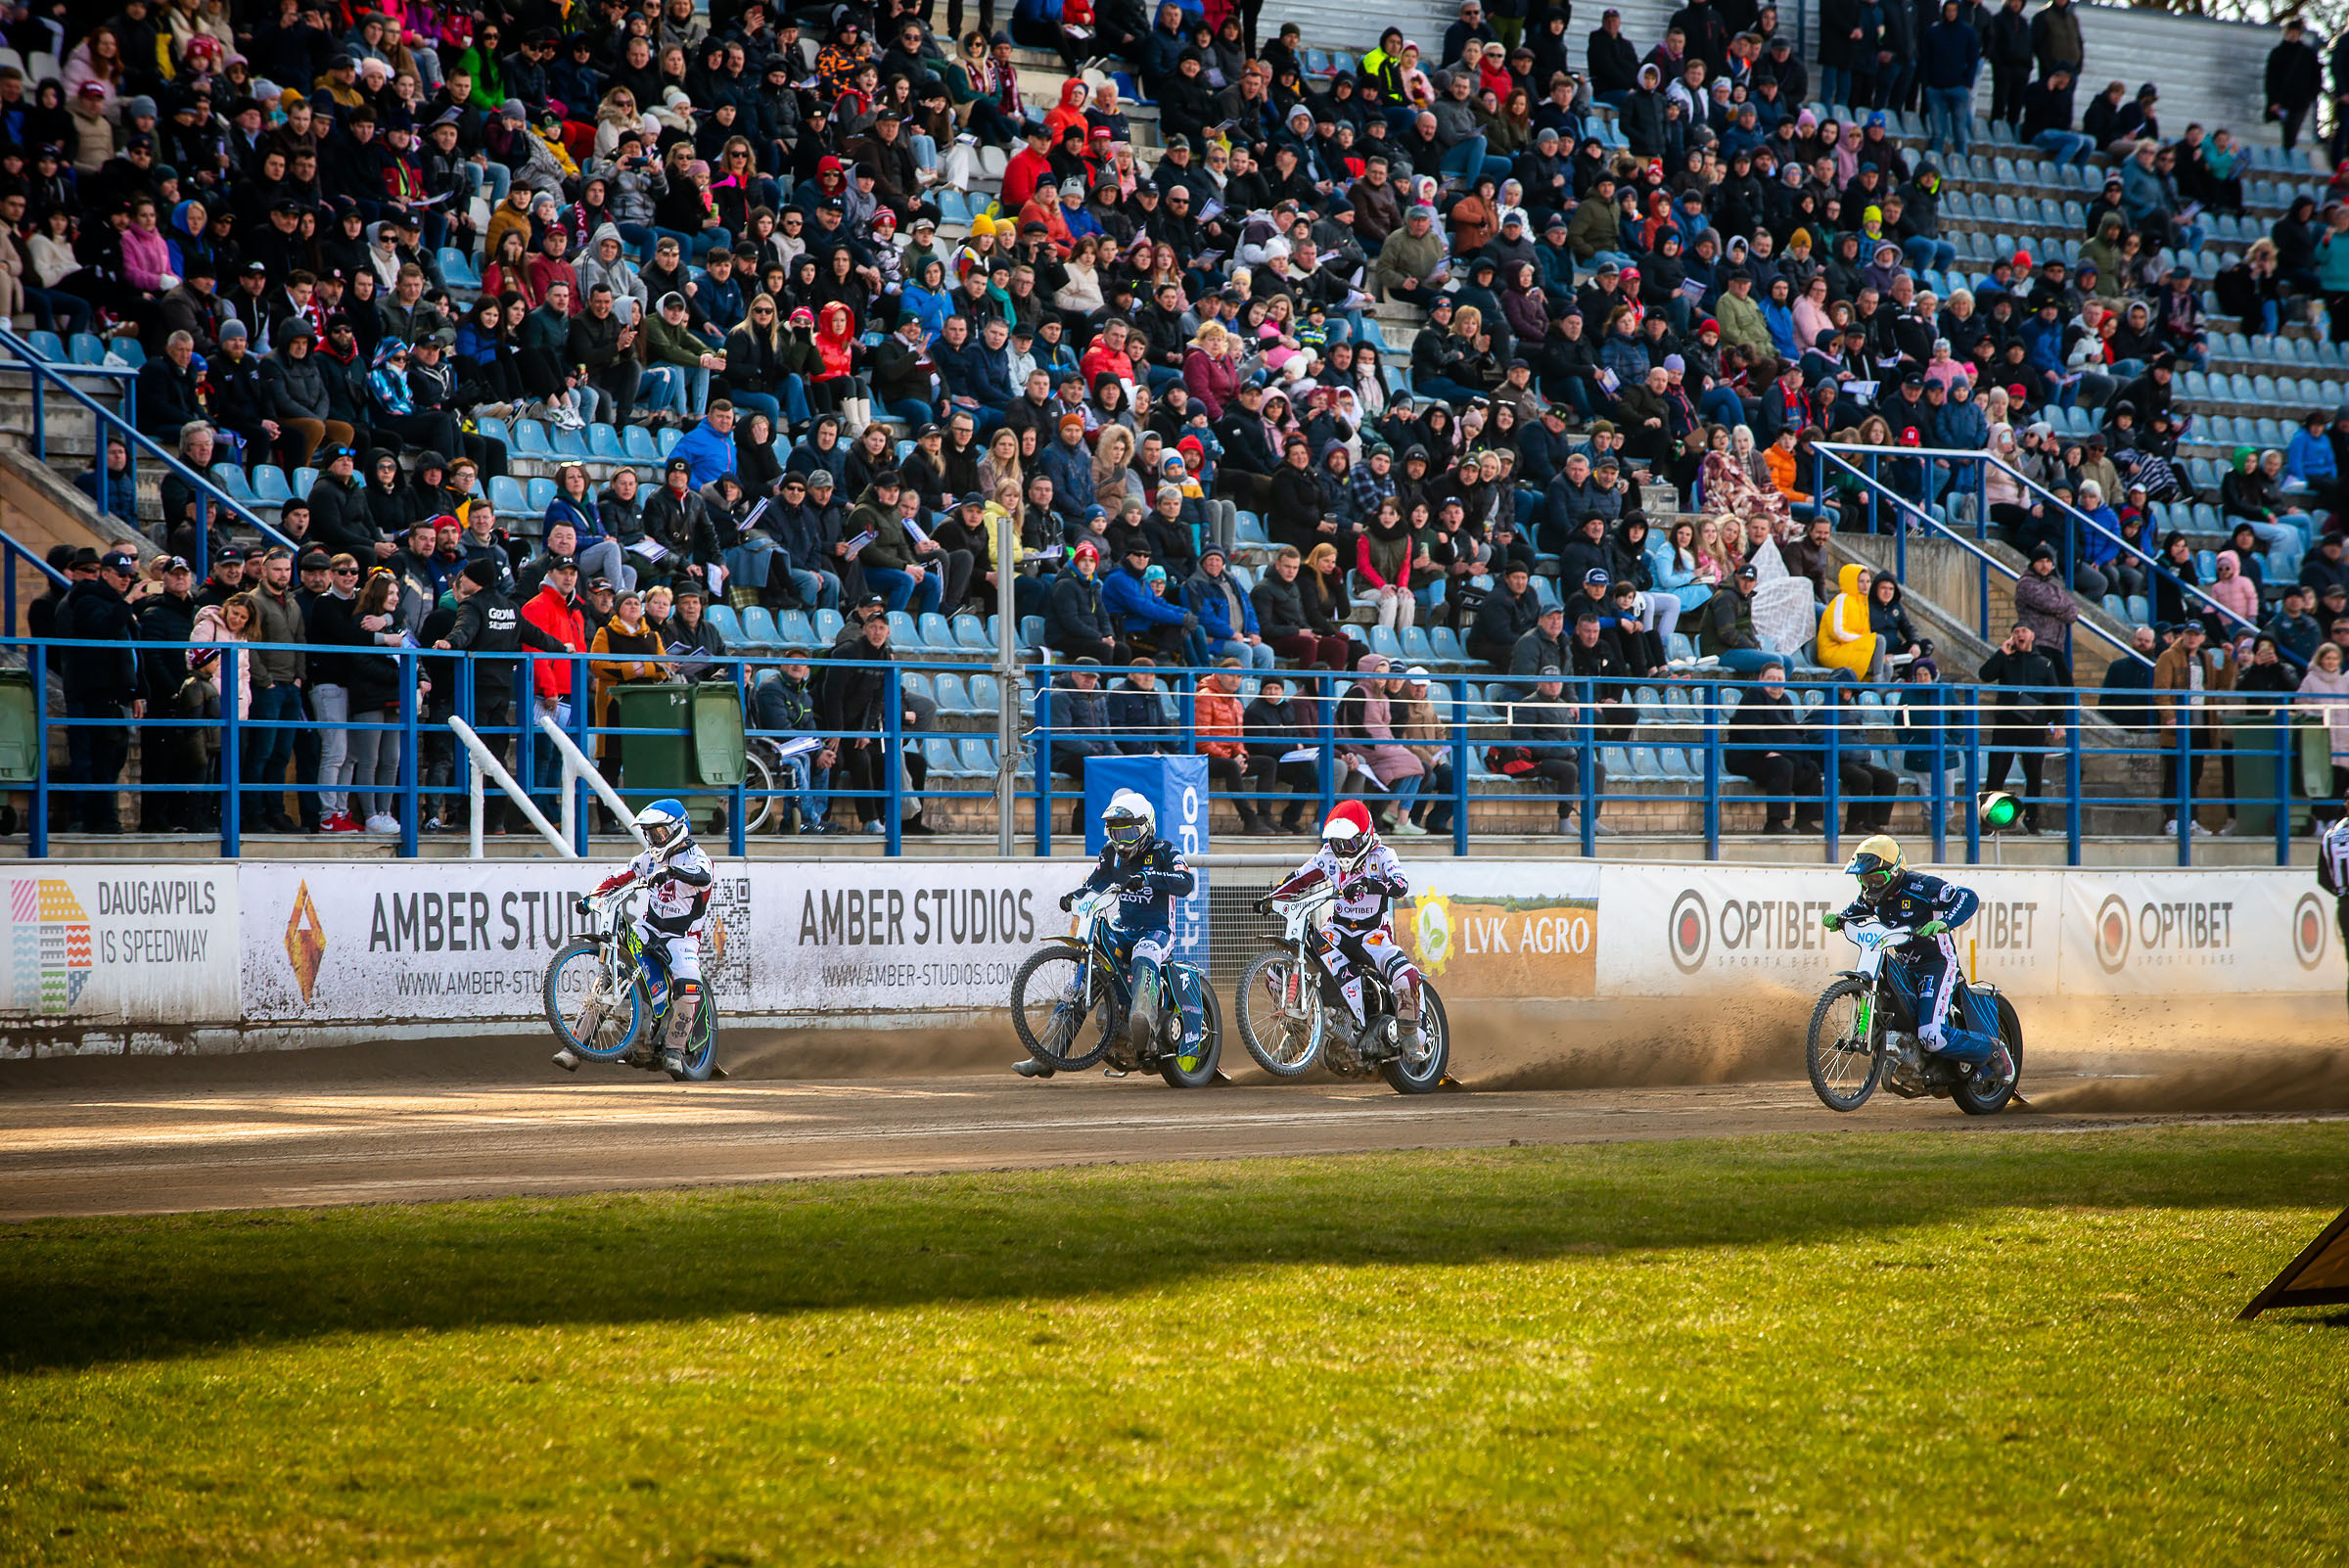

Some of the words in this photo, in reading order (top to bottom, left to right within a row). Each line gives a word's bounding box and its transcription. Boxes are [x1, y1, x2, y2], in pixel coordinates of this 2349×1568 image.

[99, 881, 216, 916] DAUGAVPILS
[798, 889, 904, 946] AMBER
[913, 888, 1035, 945] STUDIOS
[1290, 900, 1315, 911] OPTIBET
[1344, 905, 1374, 915] OPTIBET
[368, 892, 491, 952] AMBER
[1464, 917, 1512, 954] LVK
[1520, 916, 1590, 954] AGRO
[1720, 899, 1831, 950] OPTIBET
[2140, 901, 2233, 949] OPTIBET
[101, 930, 115, 964] IS
[123, 928, 208, 964] SPEEDWAY
